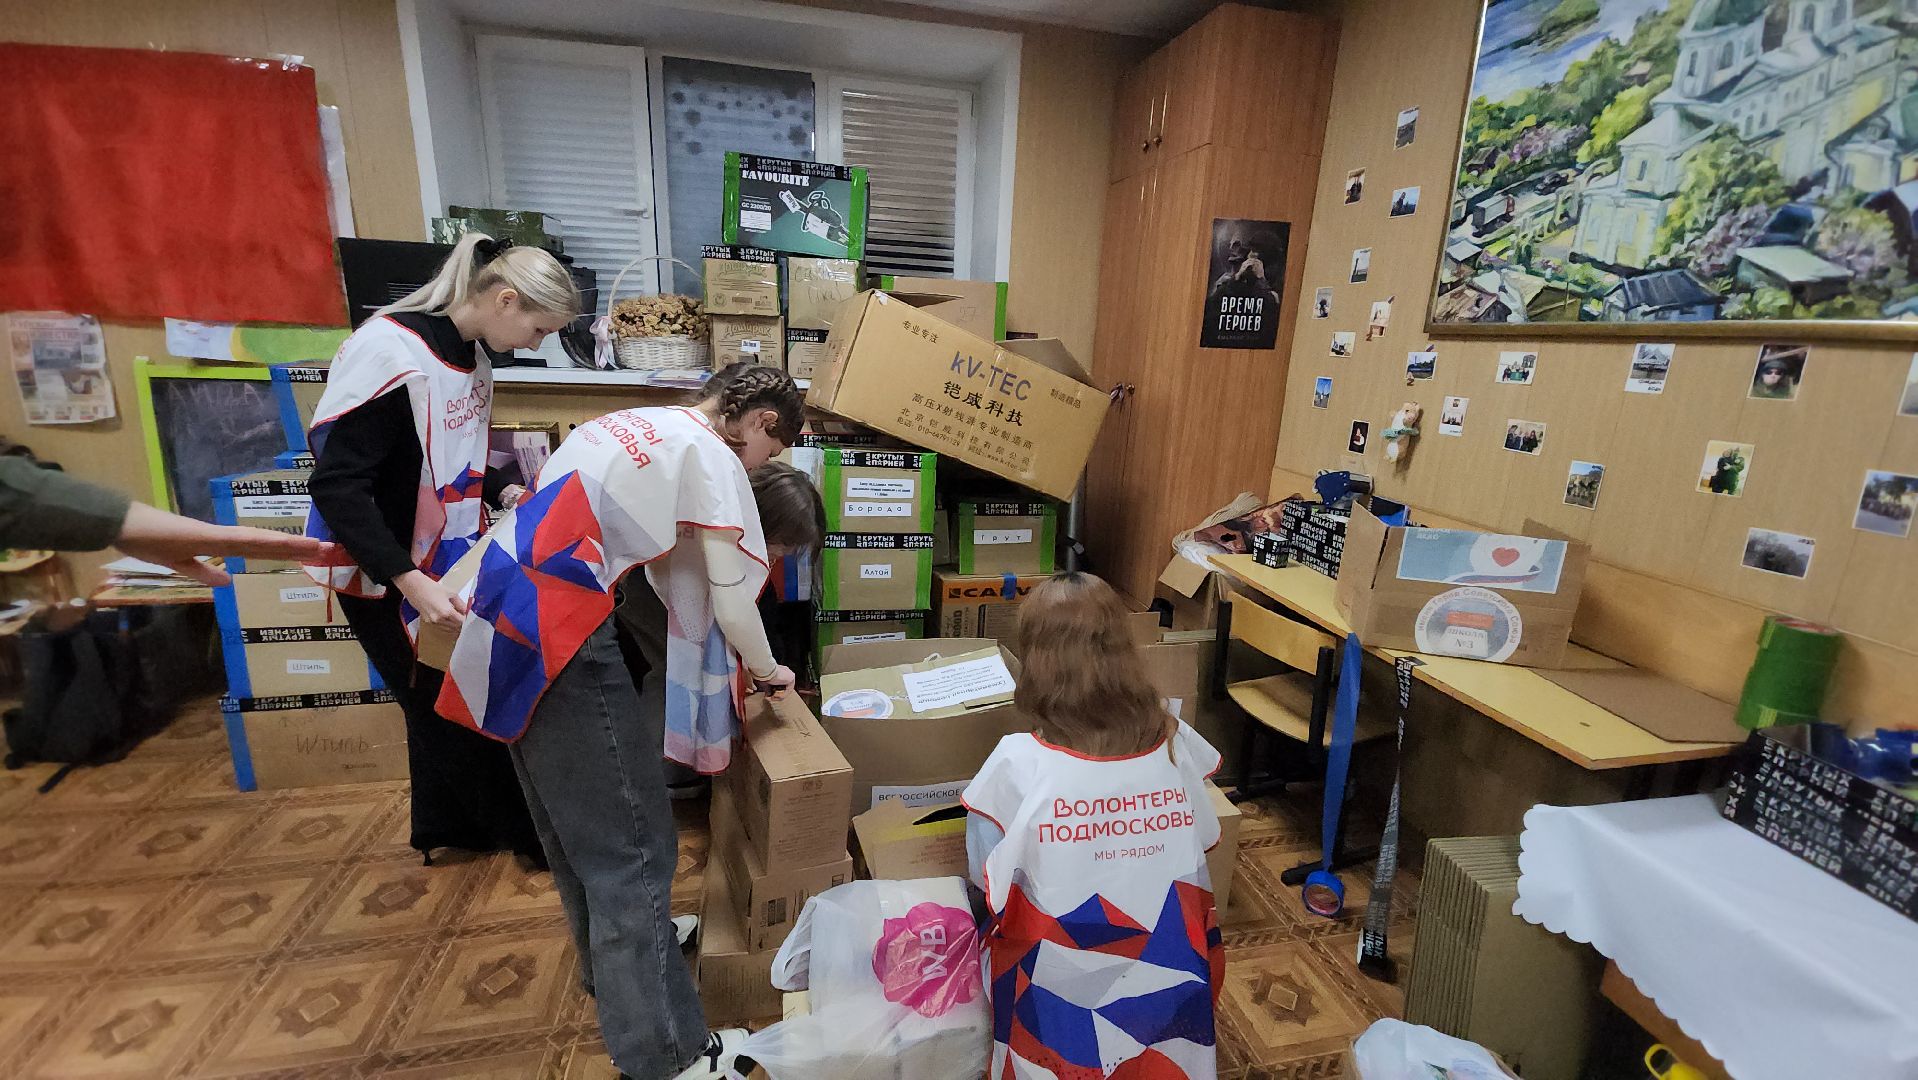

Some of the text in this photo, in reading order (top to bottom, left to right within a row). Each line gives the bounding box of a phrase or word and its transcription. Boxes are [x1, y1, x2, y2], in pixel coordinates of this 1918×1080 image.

[742, 170, 810, 187] FAVOURITE
[1220, 296, 1264, 314] ВРЕМЯ
[1218, 314, 1262, 331] ГЕРОЕВ
[950, 350, 1032, 401] kV-TEC
[943, 380, 1024, 427] 铠威科技
[871, 453, 905, 461] КРУТЫХ
[848, 504, 902, 514] Борода
[864, 568, 889, 576] Алтай
[1776, 745, 1853, 787] КРУТЫХ
[878, 787, 961, 802] ВСОССИЙСКОЕ
[1772, 769, 1845, 819] КРУТЫХ
[1094, 843, 1166, 862] МЫ РЯДОМ
[920, 924, 948, 982] WB
